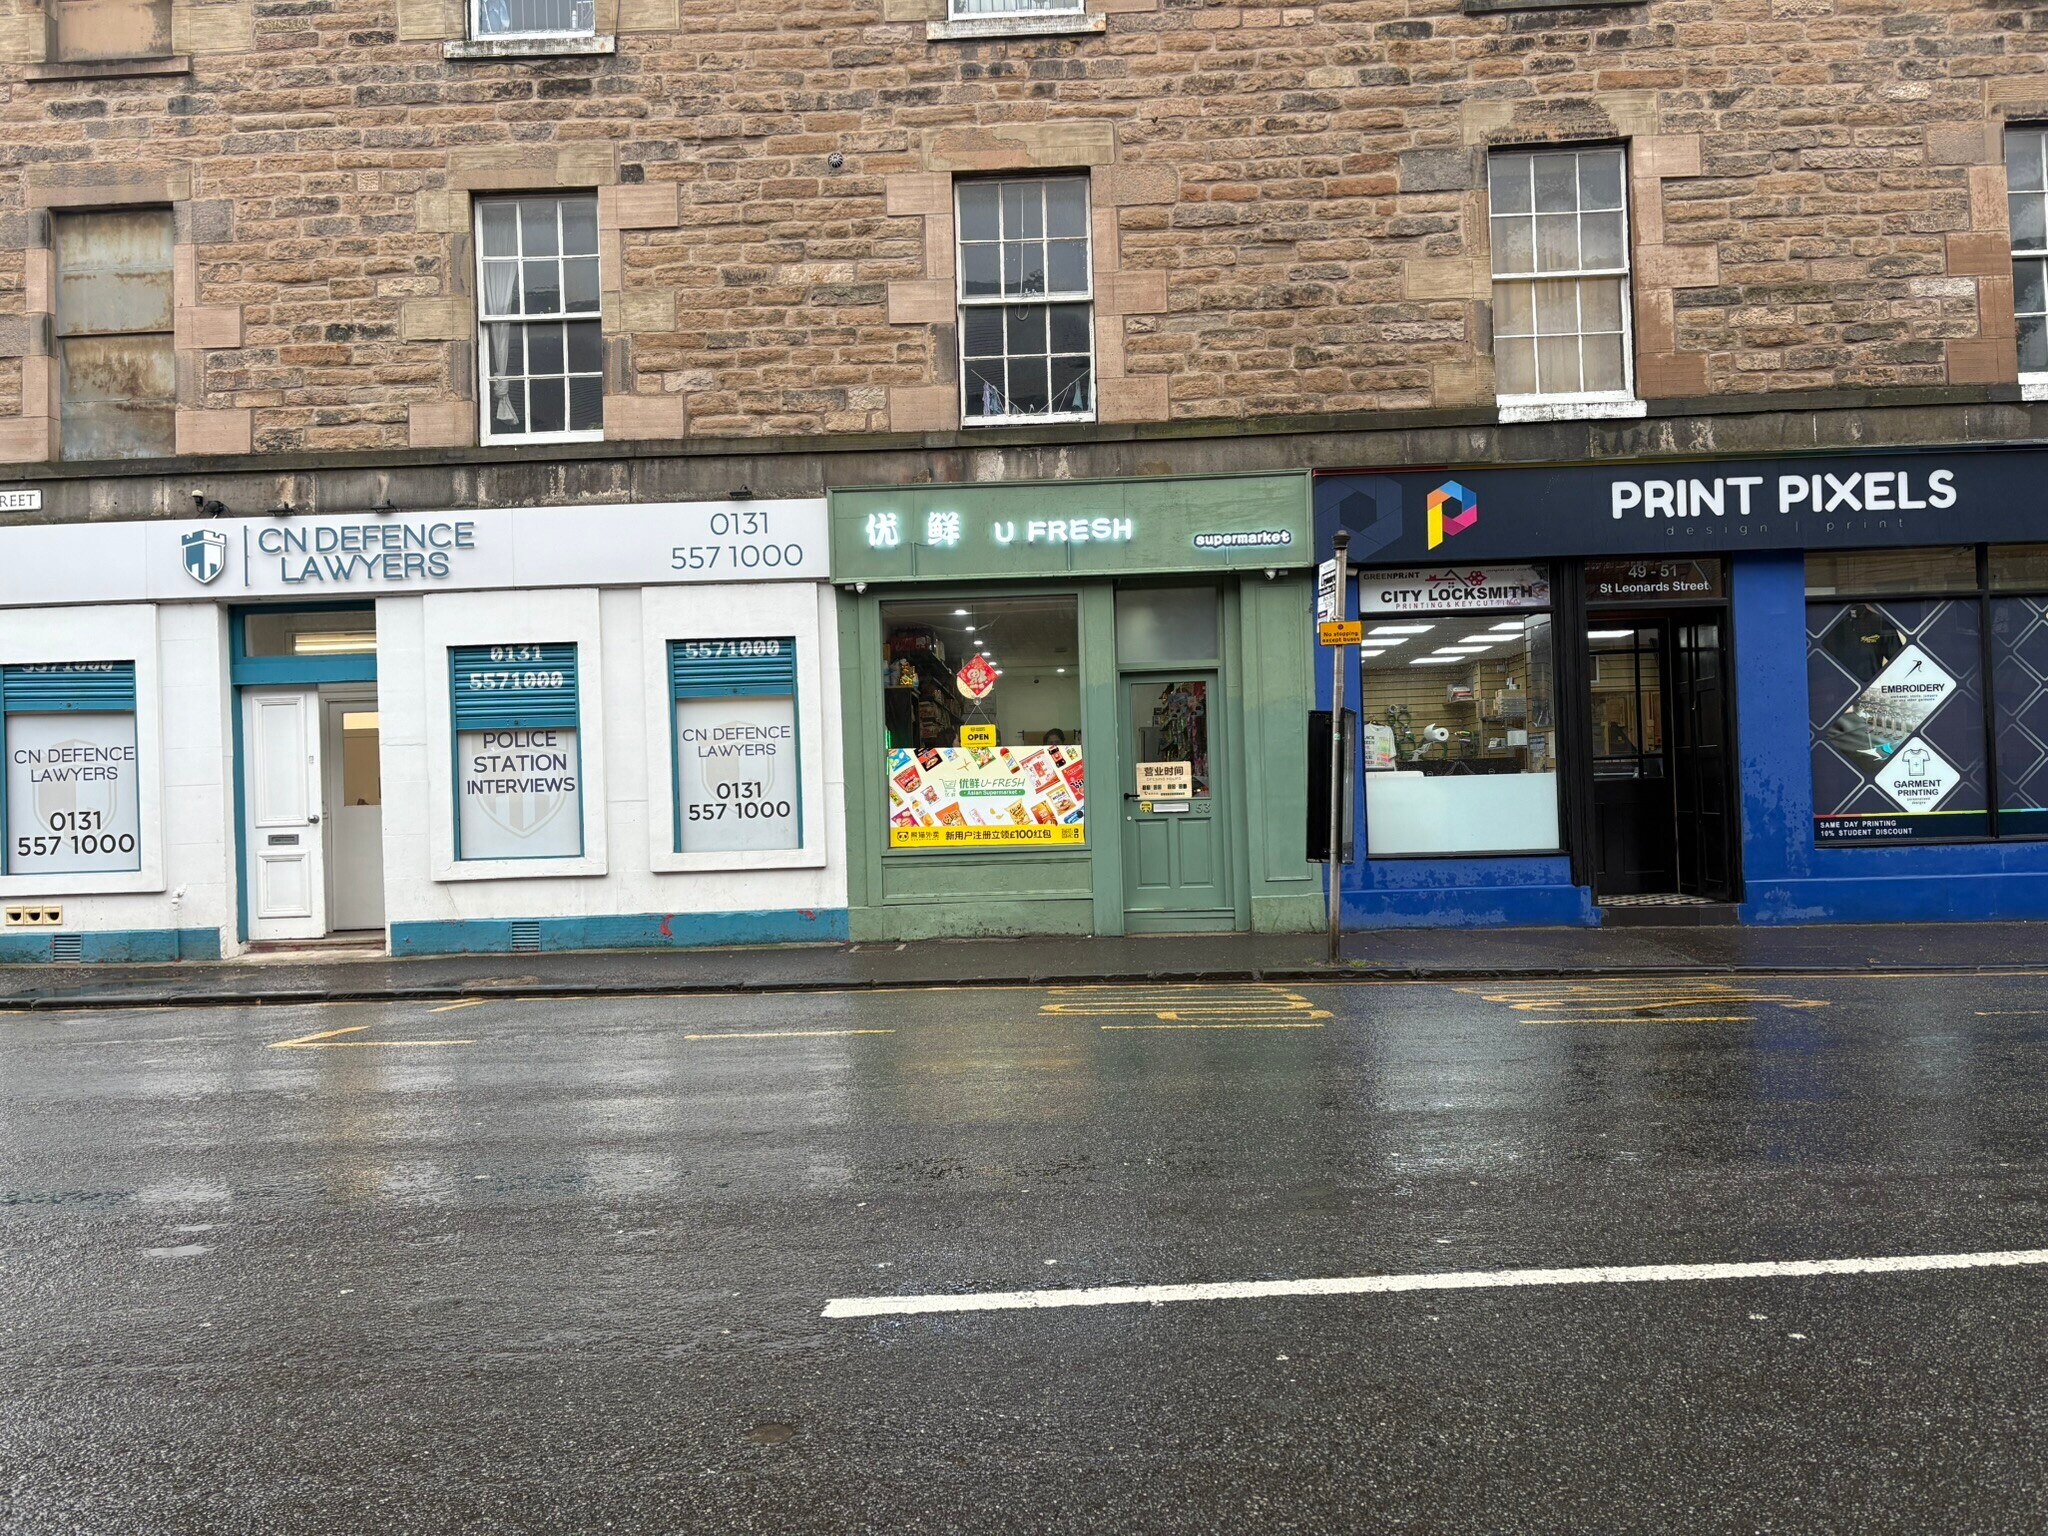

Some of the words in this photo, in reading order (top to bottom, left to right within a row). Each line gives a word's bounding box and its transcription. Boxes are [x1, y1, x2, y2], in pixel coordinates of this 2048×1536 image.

[1611, 476, 1764, 519] PRINT
[1778, 469, 1957, 514] PIXELS
[710, 512, 768, 535] 0131
[994, 520, 1014, 543] U
[1027, 517, 1132, 542] FRESH
[1666, 523, 1769, 536] design
[1826, 519, 1904, 532] print
[258, 527, 307, 553] CN
[315, 521, 475, 553] DEFENCE
[1194, 529, 1291, 548] supermarket
[671, 546, 720, 569] 557
[728, 544, 803, 567] 1000
[280, 551, 451, 583] LAWYERS
[1628, 565, 1647, 578] 49
[1660, 564, 1677, 577] 51
[1380, 589, 1423, 604] CITY
[1428, 585, 1533, 602] LOCKSMITH
[1600, 582, 1613, 593] St
[1615, 581, 1670, 593] Leonards
[1672, 580, 1709, 591] Street
[1395, 601, 1443, 610] PRINTING
[490, 644, 543, 662] 0131
[685, 640, 780, 659] 5571000
[469, 671, 564, 690] 5571000
[1881, 683, 1945, 693] EMBROIDERY
[483, 730, 557, 749] POLICE
[682, 728, 707, 742] CN
[713, 725, 791, 740] DEFENCE
[967, 733, 989, 741] OPEN
[14, 749, 41, 764] CN
[48, 746, 135, 763] DEFENCE
[698, 743, 776, 758] LAWYERS
[473, 753, 567, 774] STATION
[1144, 766, 1184, 776] 营业时间
[31, 767, 119, 783] LAWYERS
[959, 778, 980, 789] 优鲜
[1893, 779, 1942, 788] GARMENT
[467, 777, 576, 795] INTERVIEWS
[716, 781, 761, 799] 0131
[1897, 788, 1939, 797] PRINTING
[689, 803, 727, 821] 557
[735, 801, 791, 819] 1000
[1196, 803, 1211, 813] 53
[49, 810, 102, 832] 0131
[1820, 821, 1840, 829] SAME
[1821, 829, 1835, 837] 10%
[1875, 827, 1913, 835] DISCOUNT
[17, 836, 62, 857] 557
[70, 833, 135, 855] 1000
